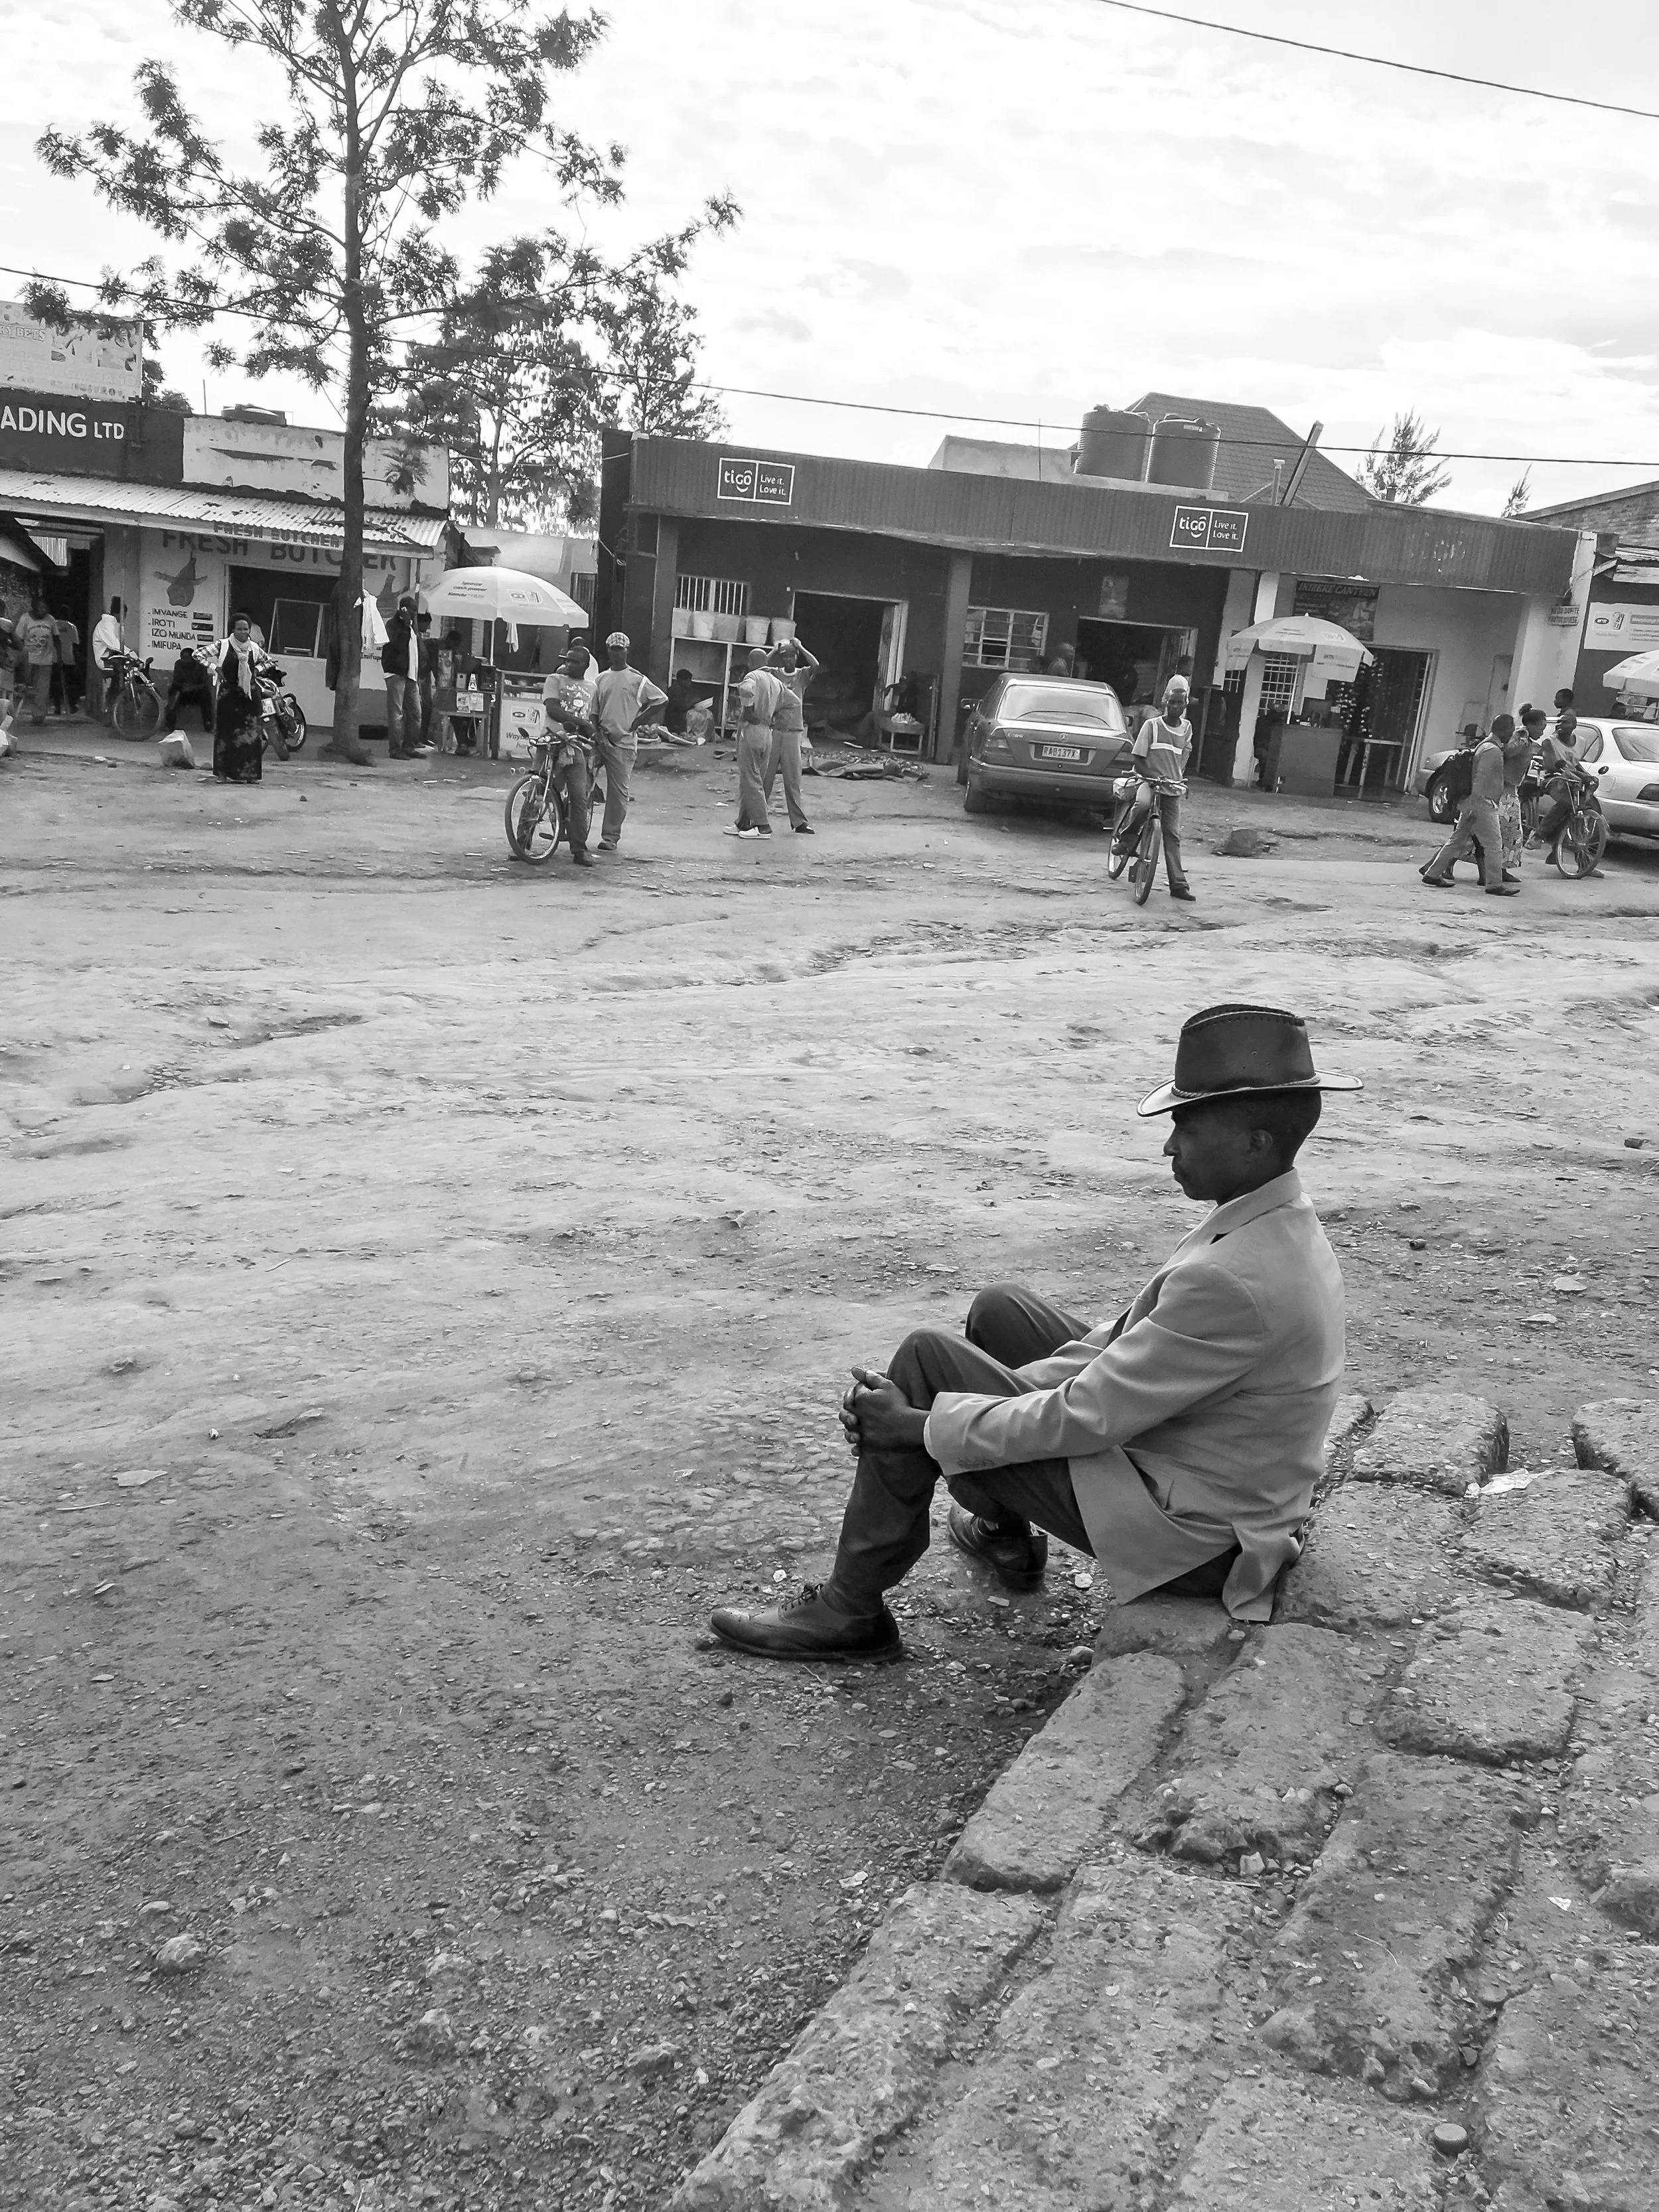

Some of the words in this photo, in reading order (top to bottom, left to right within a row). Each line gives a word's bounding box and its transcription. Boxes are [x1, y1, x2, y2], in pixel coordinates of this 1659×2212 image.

[16, 327, 45, 341] BETS
[1, 406, 86, 437] ADING
[94, 421, 124, 439] LTD
[725, 470, 753, 492] tigo
[760, 474, 775, 484] Live
[760, 484, 777, 494] Love
[1179, 516, 1206, 538] tigo
[1214, 520, 1229, 530] Live
[214, 522, 263, 538] FRESH
[271, 527, 339, 548] BUTCHER
[1213, 530, 1230, 540] Love
[163, 530, 248, 555] FRESH
[271, 544, 396, 571] BUTCER
[1299, 583, 1333, 593] IKIZERE
[1335, 585, 1376, 597] CANTEEN
[152, 608, 188, 619] IMVANGE
[152, 618, 175, 628] IROTI
[151, 628, 167, 637] IZO
[169, 630, 196, 641] MUNDA
[151, 640, 181, 650] IMIFUPA
